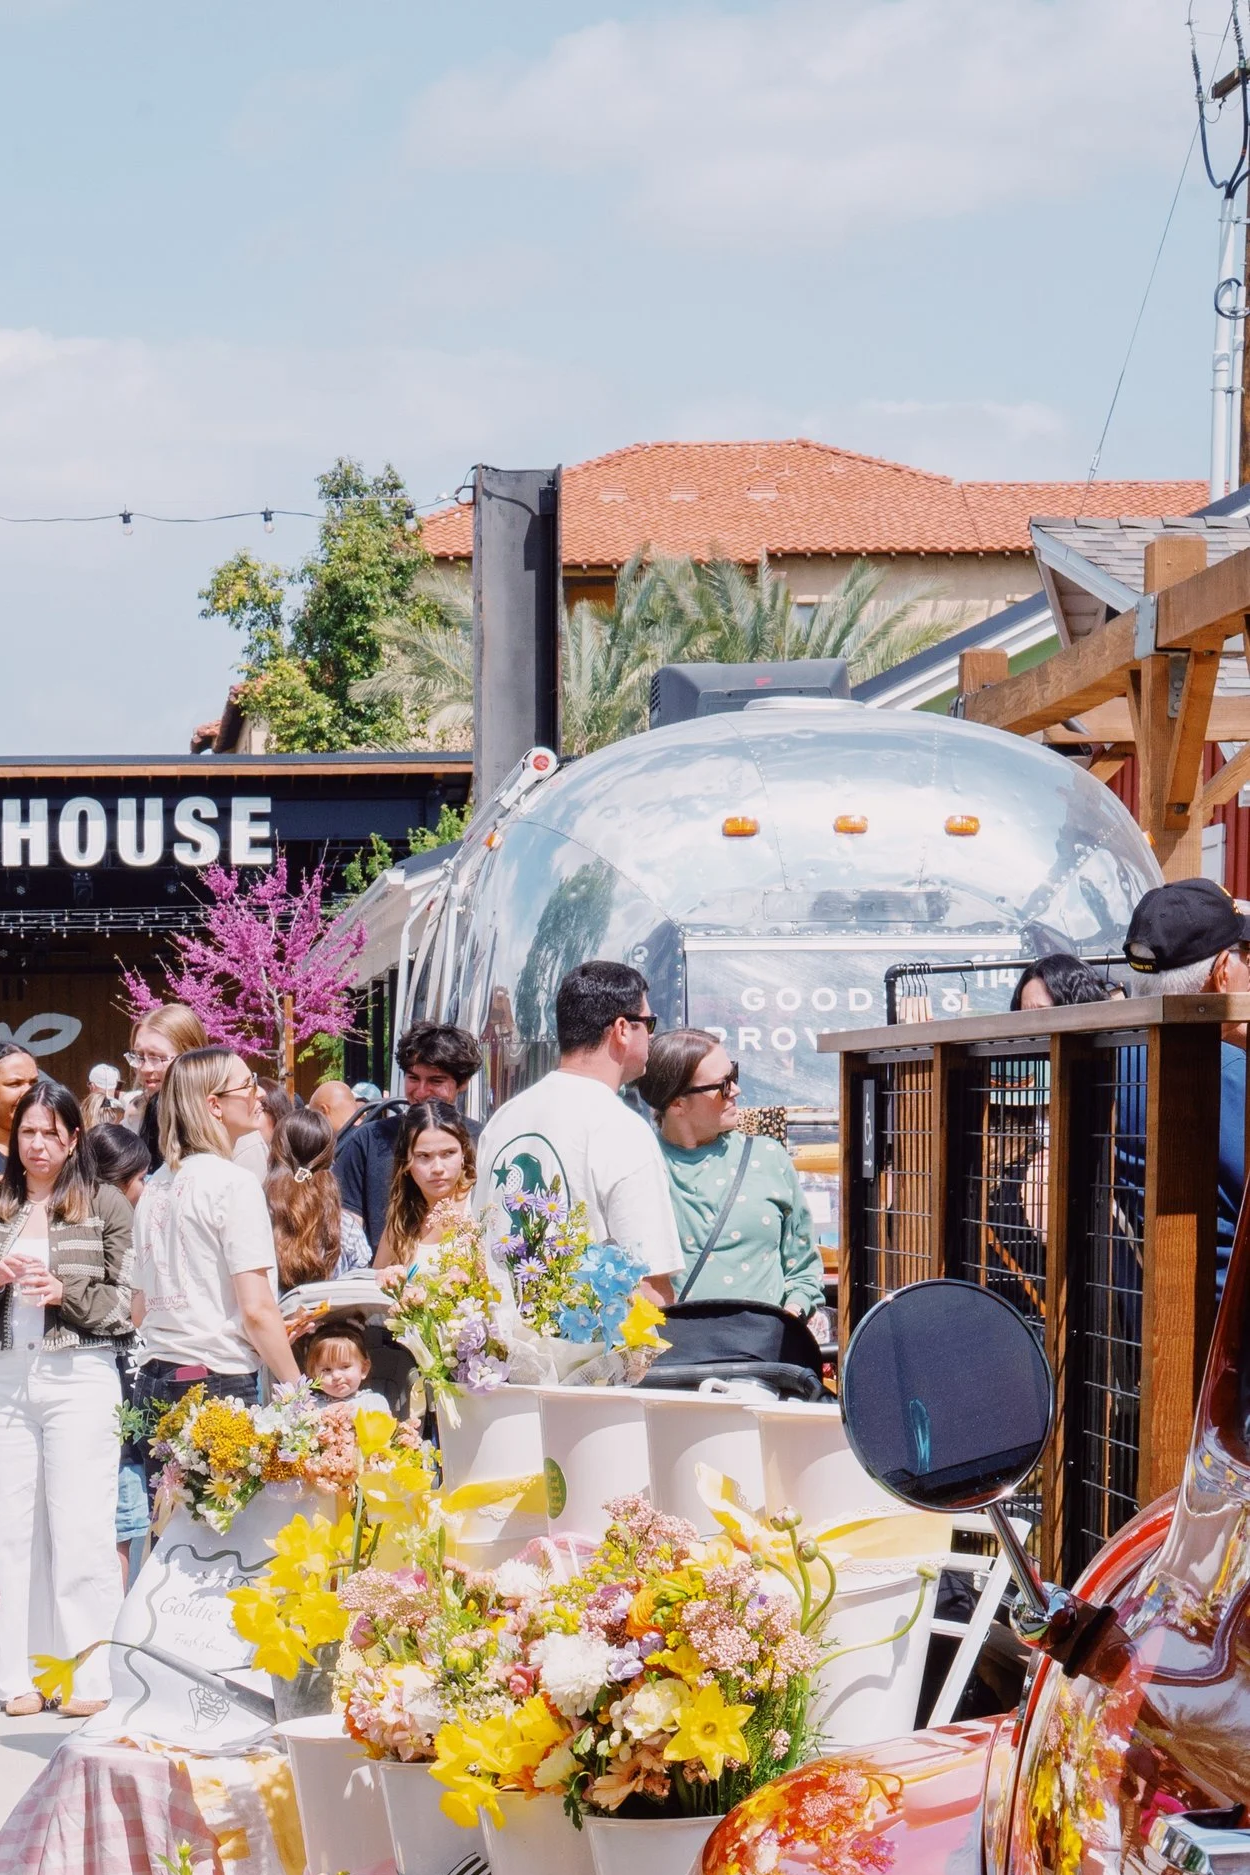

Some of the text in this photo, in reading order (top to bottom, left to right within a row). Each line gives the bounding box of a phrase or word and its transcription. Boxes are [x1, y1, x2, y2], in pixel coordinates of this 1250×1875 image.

[1, 796, 273, 868] HOUSE
[741, 987, 901, 1012] GOOD
[160, 1596, 221, 1622] Goldie
